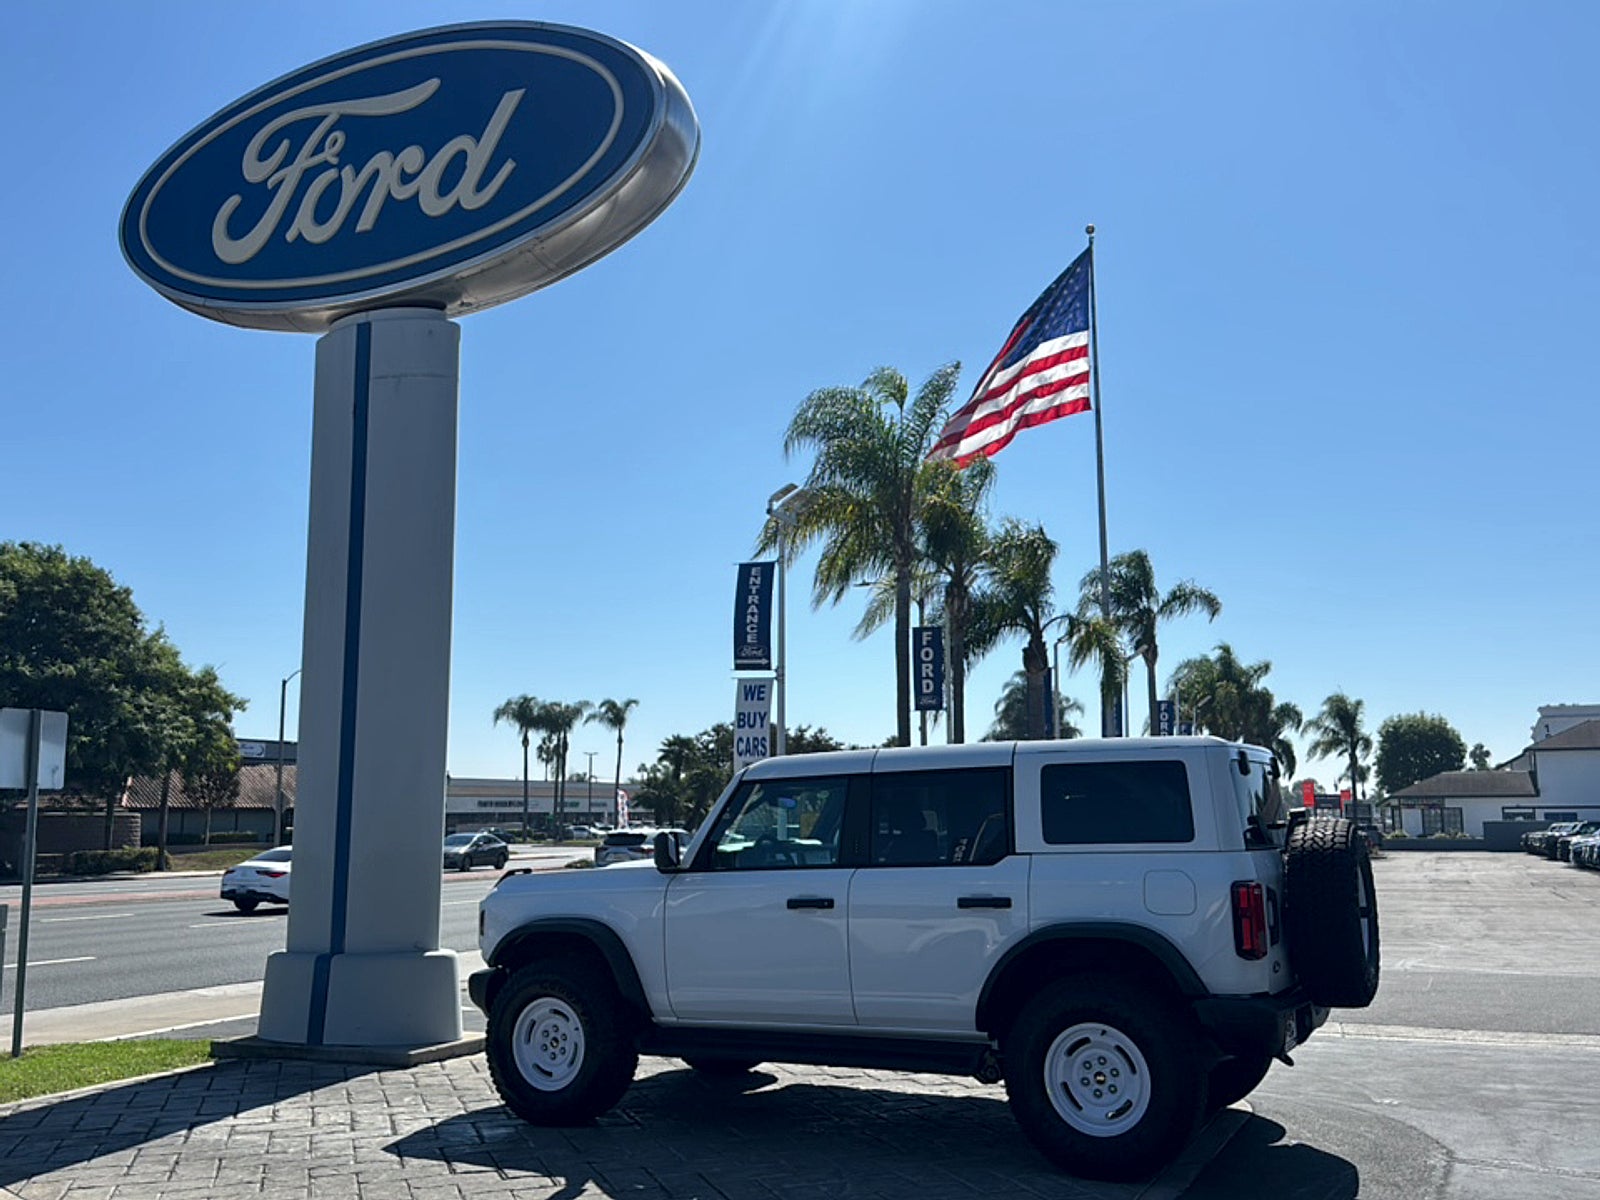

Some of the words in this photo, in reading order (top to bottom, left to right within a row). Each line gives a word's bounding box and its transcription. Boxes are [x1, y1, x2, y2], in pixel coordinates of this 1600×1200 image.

[211, 77, 527, 265] Ford
[746, 567, 761, 643] ENTRANCE
[920, 631, 935, 694] FORD
[743, 684, 766, 701] WE
[737, 711, 767, 729] BUY
[736, 736, 768, 757] CARS
